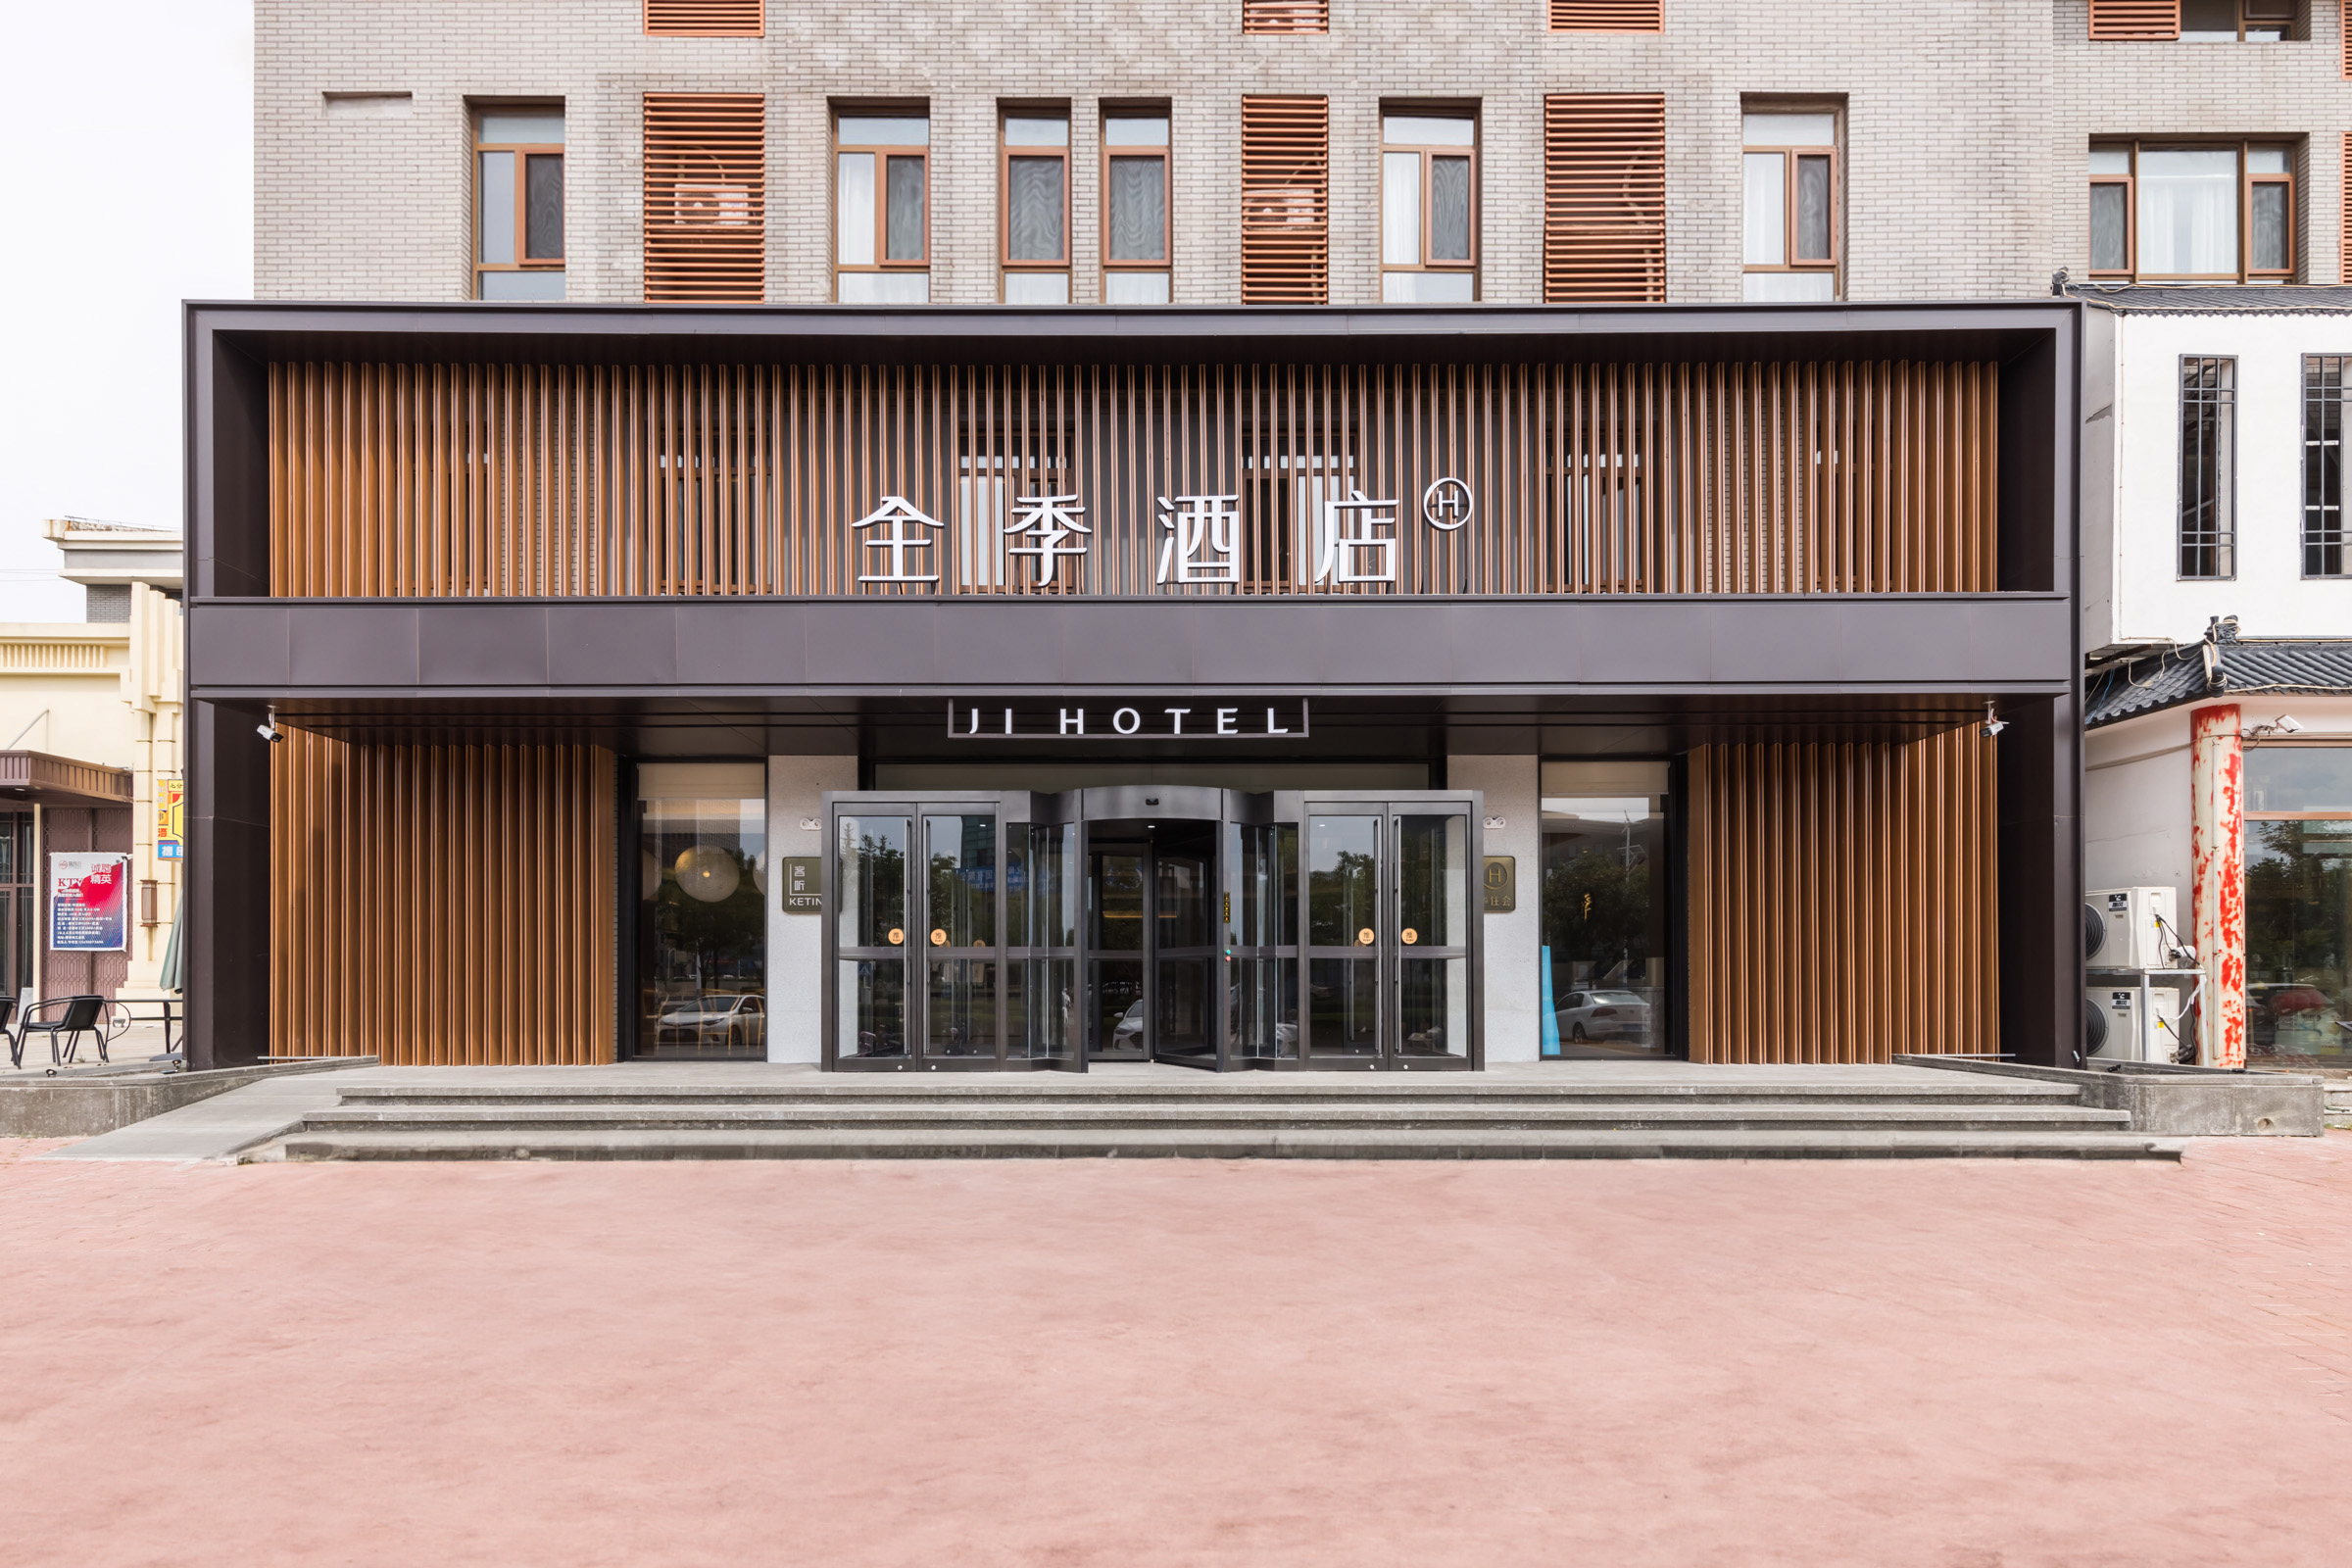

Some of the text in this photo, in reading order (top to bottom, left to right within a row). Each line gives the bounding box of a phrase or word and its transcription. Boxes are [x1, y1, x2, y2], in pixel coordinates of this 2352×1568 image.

[851, 490, 1400, 589] 全季酒店
[969, 707, 1289, 735] JI HOTEL
[58, 878, 83, 887] KTV
